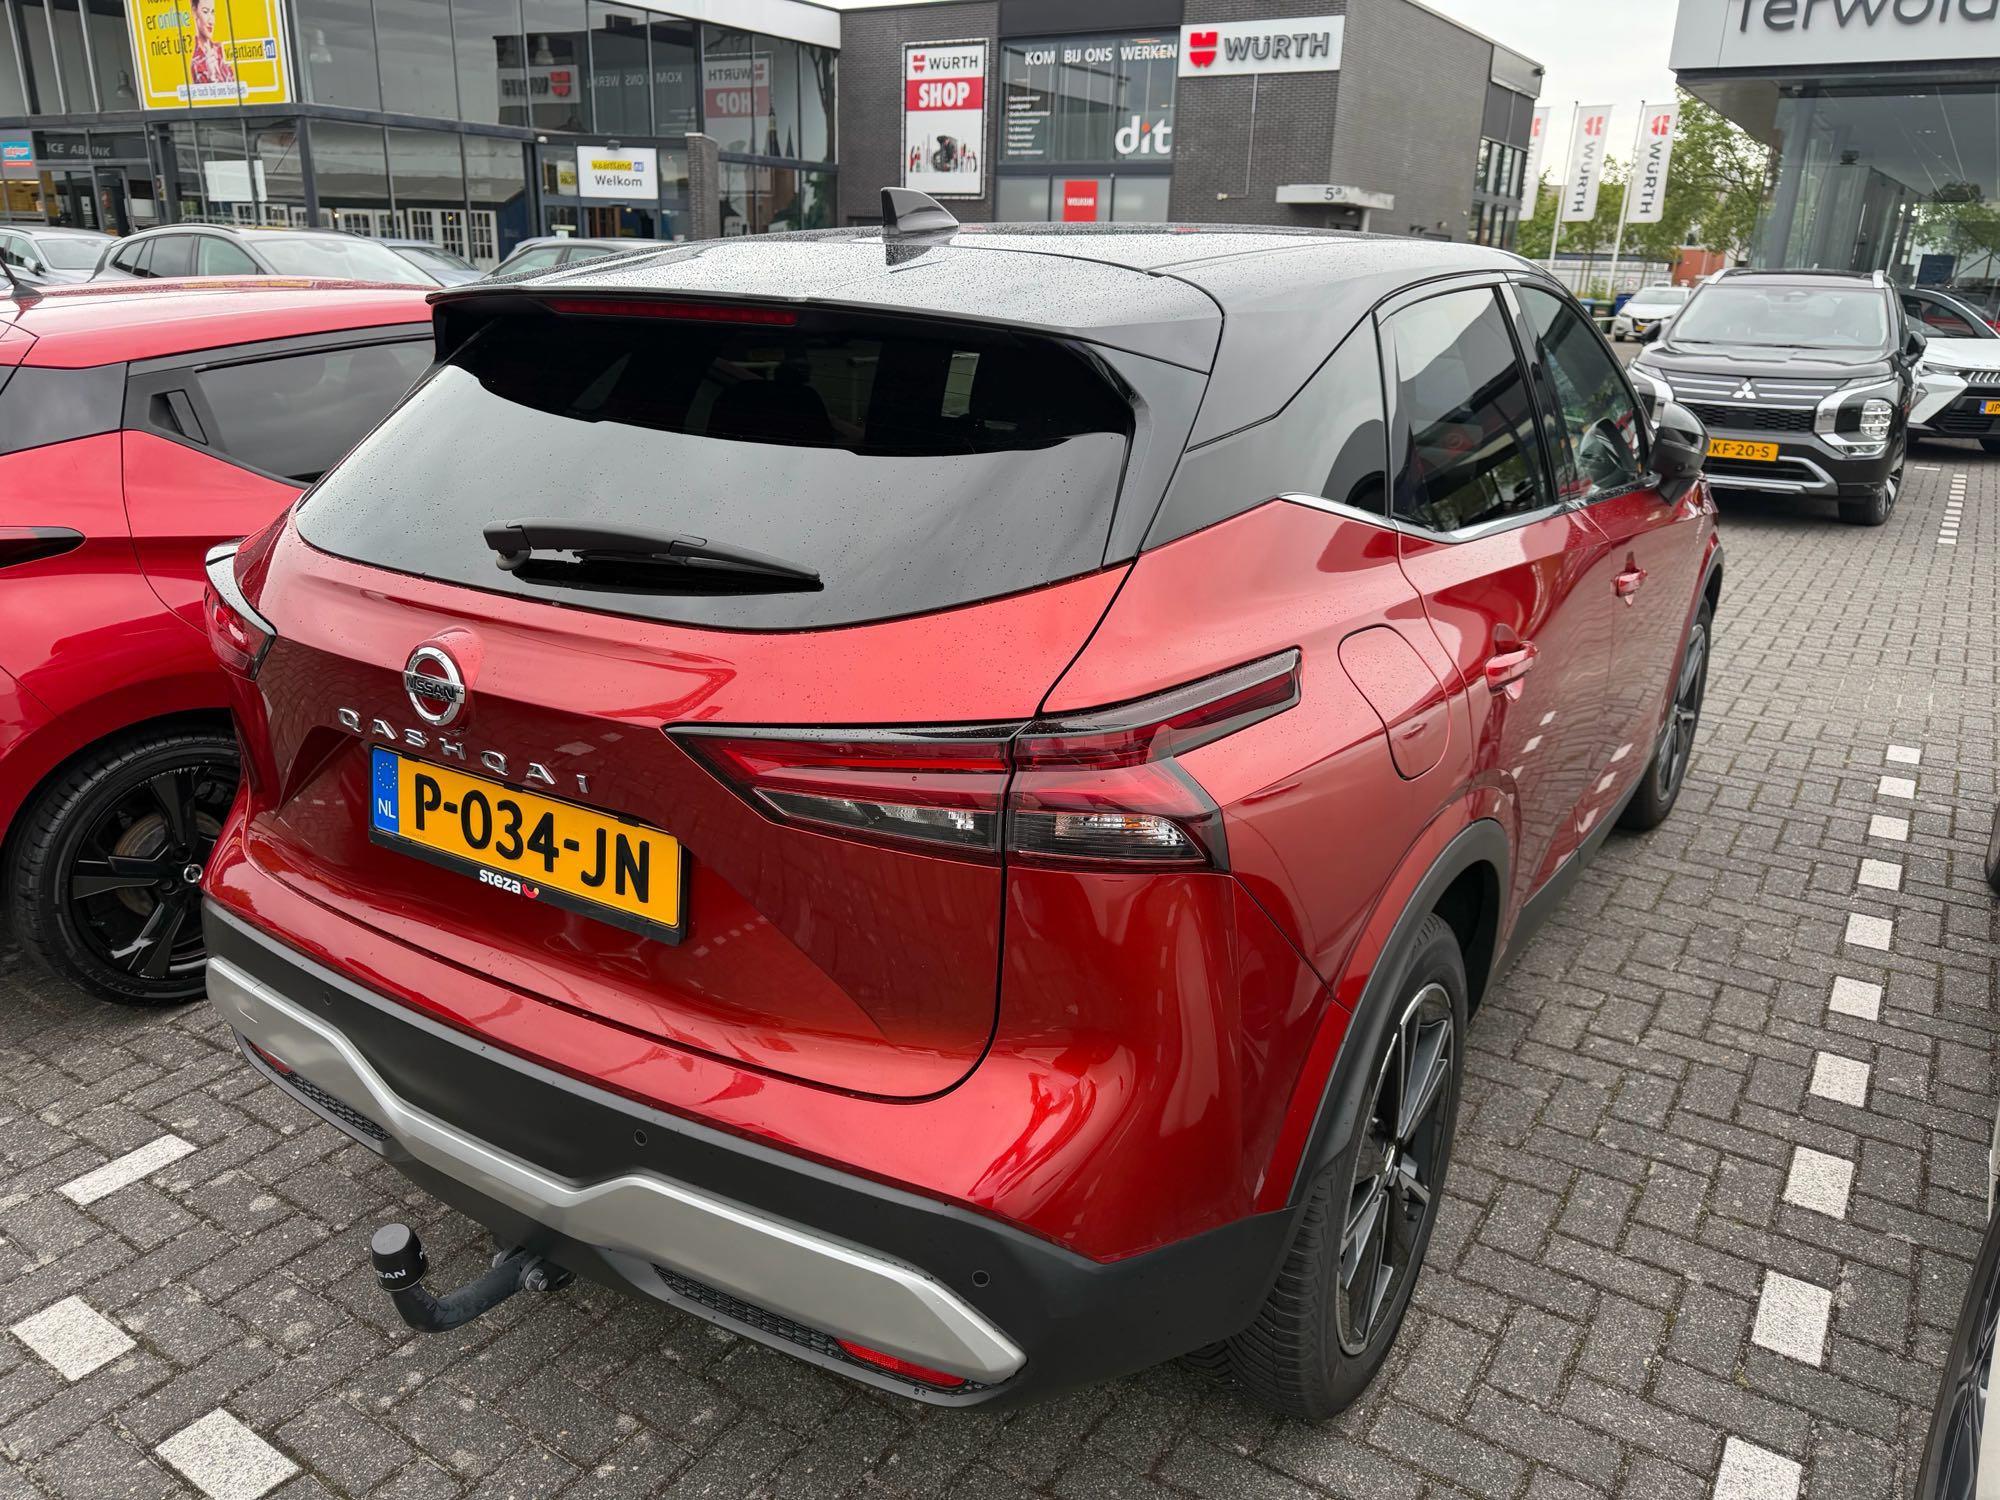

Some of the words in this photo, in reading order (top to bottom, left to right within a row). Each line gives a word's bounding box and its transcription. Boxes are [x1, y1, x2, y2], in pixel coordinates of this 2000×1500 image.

[146, 15, 156, 30] er
[151, 36, 172, 56] niet
[174, 34, 193, 54] ut?
[1025, 51, 1056, 66] KOM
[1064, 49, 1082, 63] BIJ
[1084, 47, 1113, 62] ONS
[1120, 43, 1177, 61] WERKEN
[1224, 32, 1330, 61] WÜRTH
[929, 55, 978, 69] WÜRTH
[919, 82, 971, 108] SHOP
[1114, 115, 1172, 155] dit
[594, 175, 642, 187] Welkom
[1640, 141, 1663, 214] WÜRTH
[407, 676, 456, 702] NISSAN
[337, 707, 590, 794] QASHQAI
[378, 798, 396, 820] NL
[414, 772, 650, 904] P-034-JN
[480, 870, 520, 895] steza
